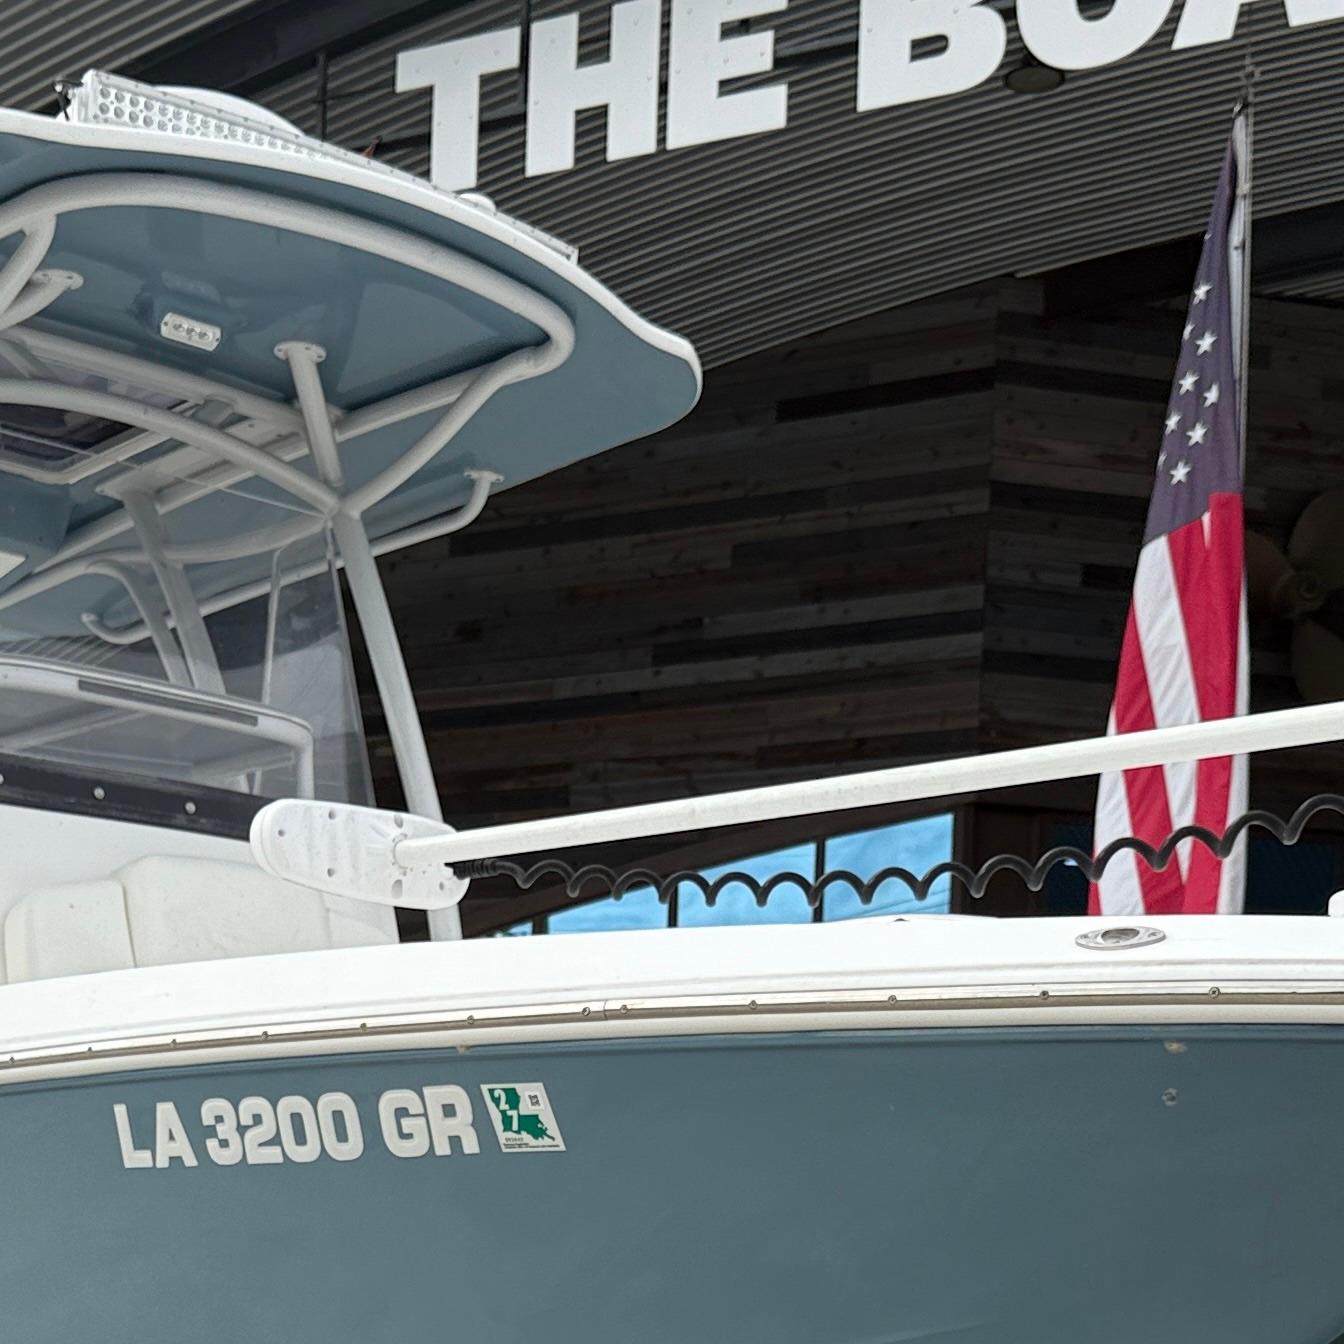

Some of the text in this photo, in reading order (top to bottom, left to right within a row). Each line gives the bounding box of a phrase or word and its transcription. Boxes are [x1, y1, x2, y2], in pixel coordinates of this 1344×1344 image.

[394, 0, 789, 191] THE
[113, 1084, 481, 1169] LA 3200 GR
